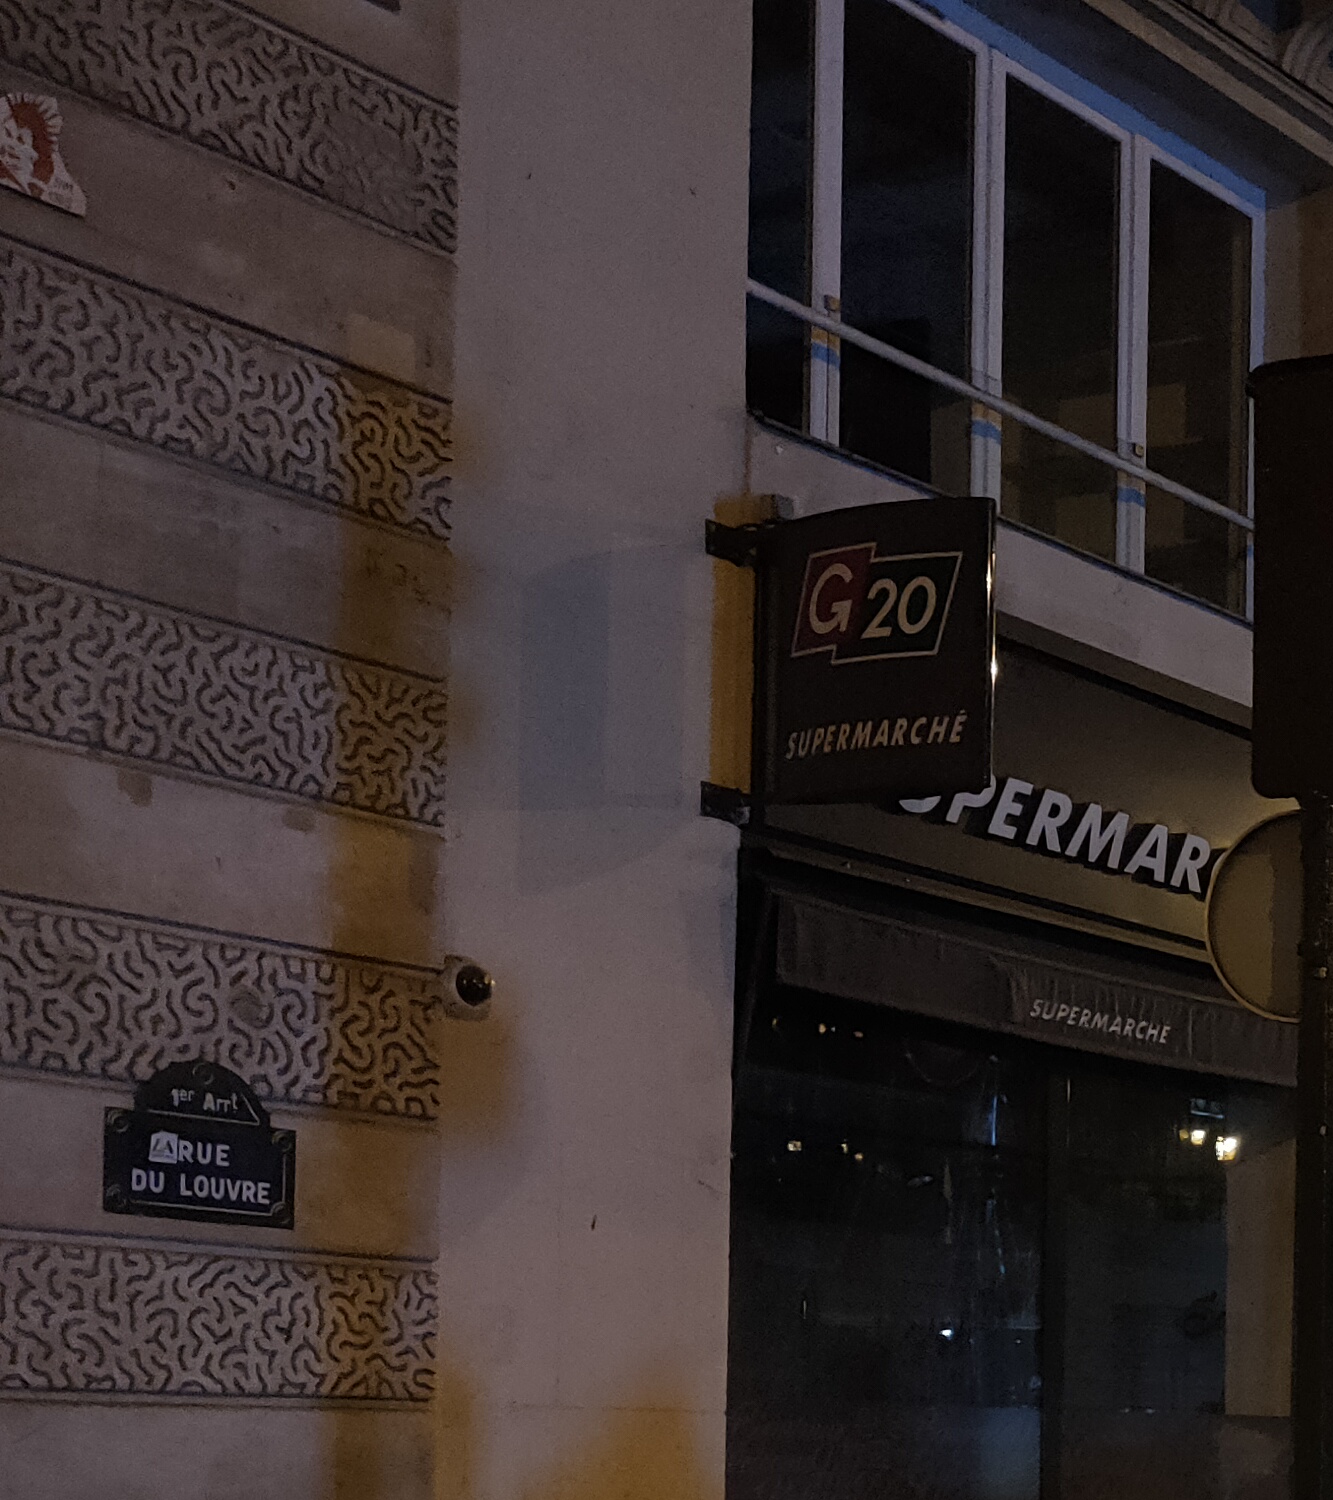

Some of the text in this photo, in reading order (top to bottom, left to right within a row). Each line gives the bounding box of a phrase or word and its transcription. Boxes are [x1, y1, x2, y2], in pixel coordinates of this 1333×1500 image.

[808, 562, 938, 640] G20
[785, 708, 969, 761] SUPERMARCHÉ
[898, 774, 1211, 894] PERMAR
[178, 1138, 231, 1168] RUE
[131, 1167, 272, 1205] DU LOUVRE
